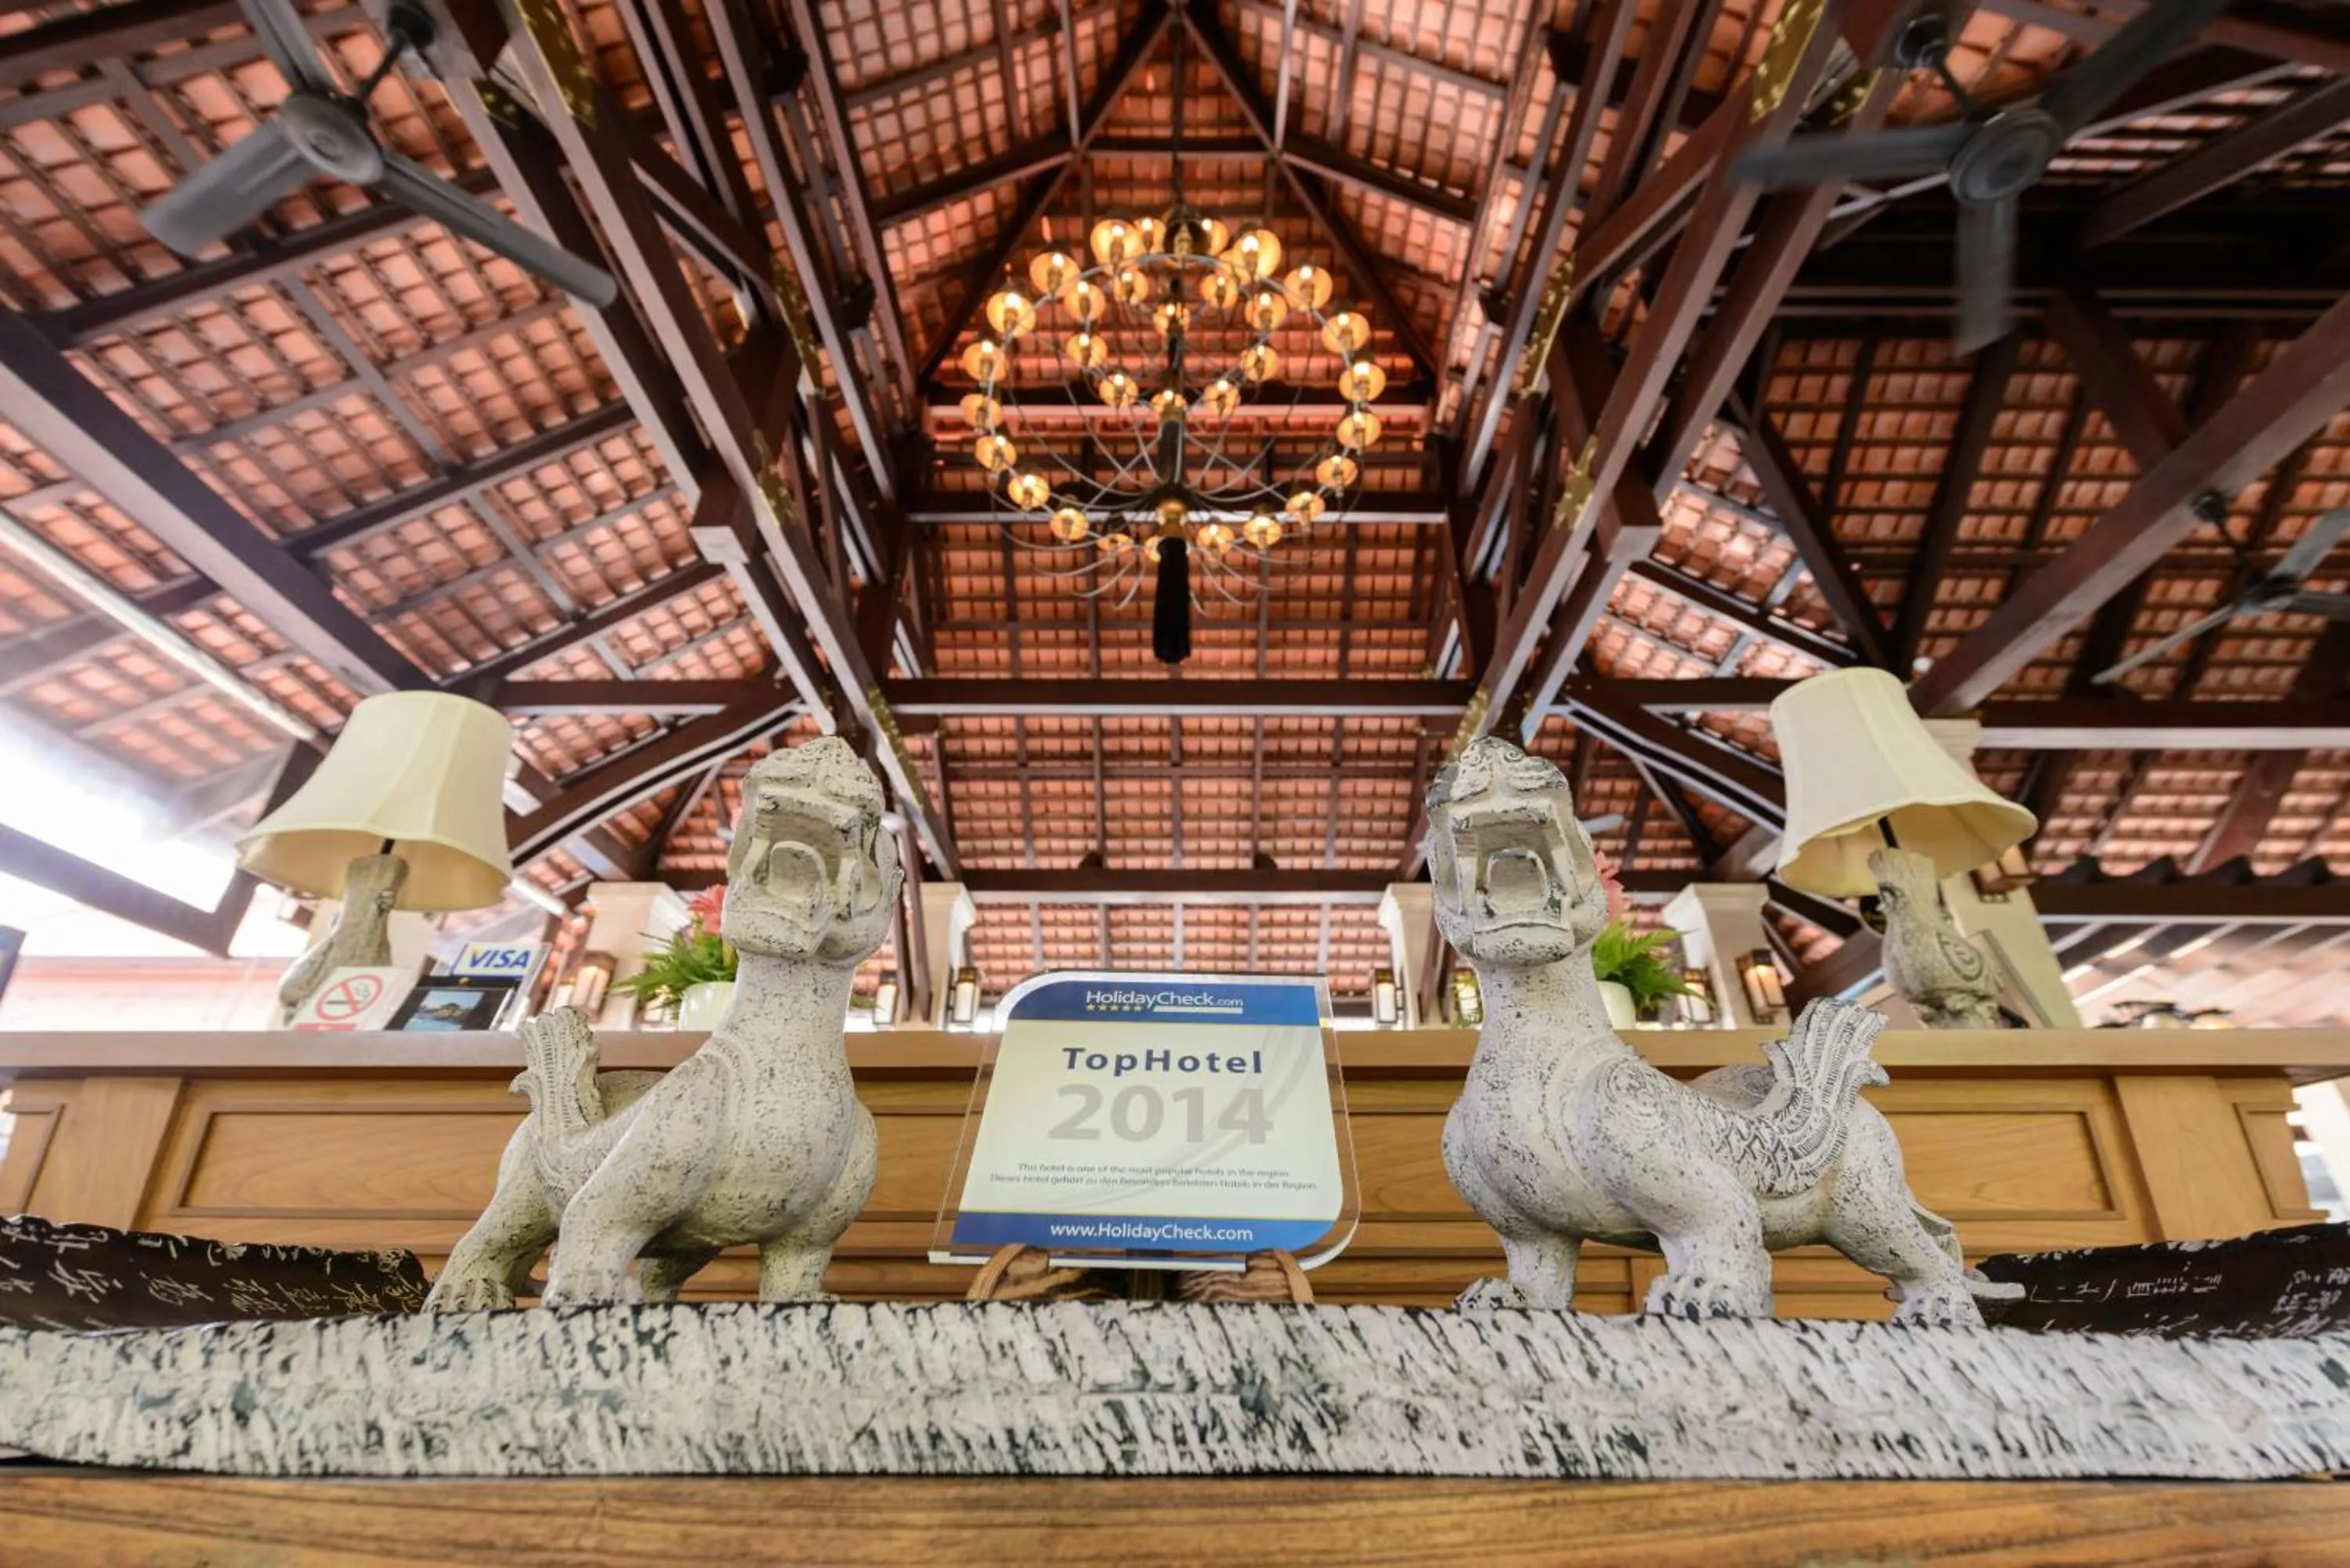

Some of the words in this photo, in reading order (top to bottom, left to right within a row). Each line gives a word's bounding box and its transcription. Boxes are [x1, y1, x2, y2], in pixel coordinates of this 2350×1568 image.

[468, 949, 531, 969] VISA
[1086, 990, 1243, 1009] HolidayCheck.com
[1062, 1047, 1263, 1077] TopHotel
[1047, 1083, 1274, 1145] 2014
[1050, 1223, 1253, 1241] www.HolidayCheck.com
